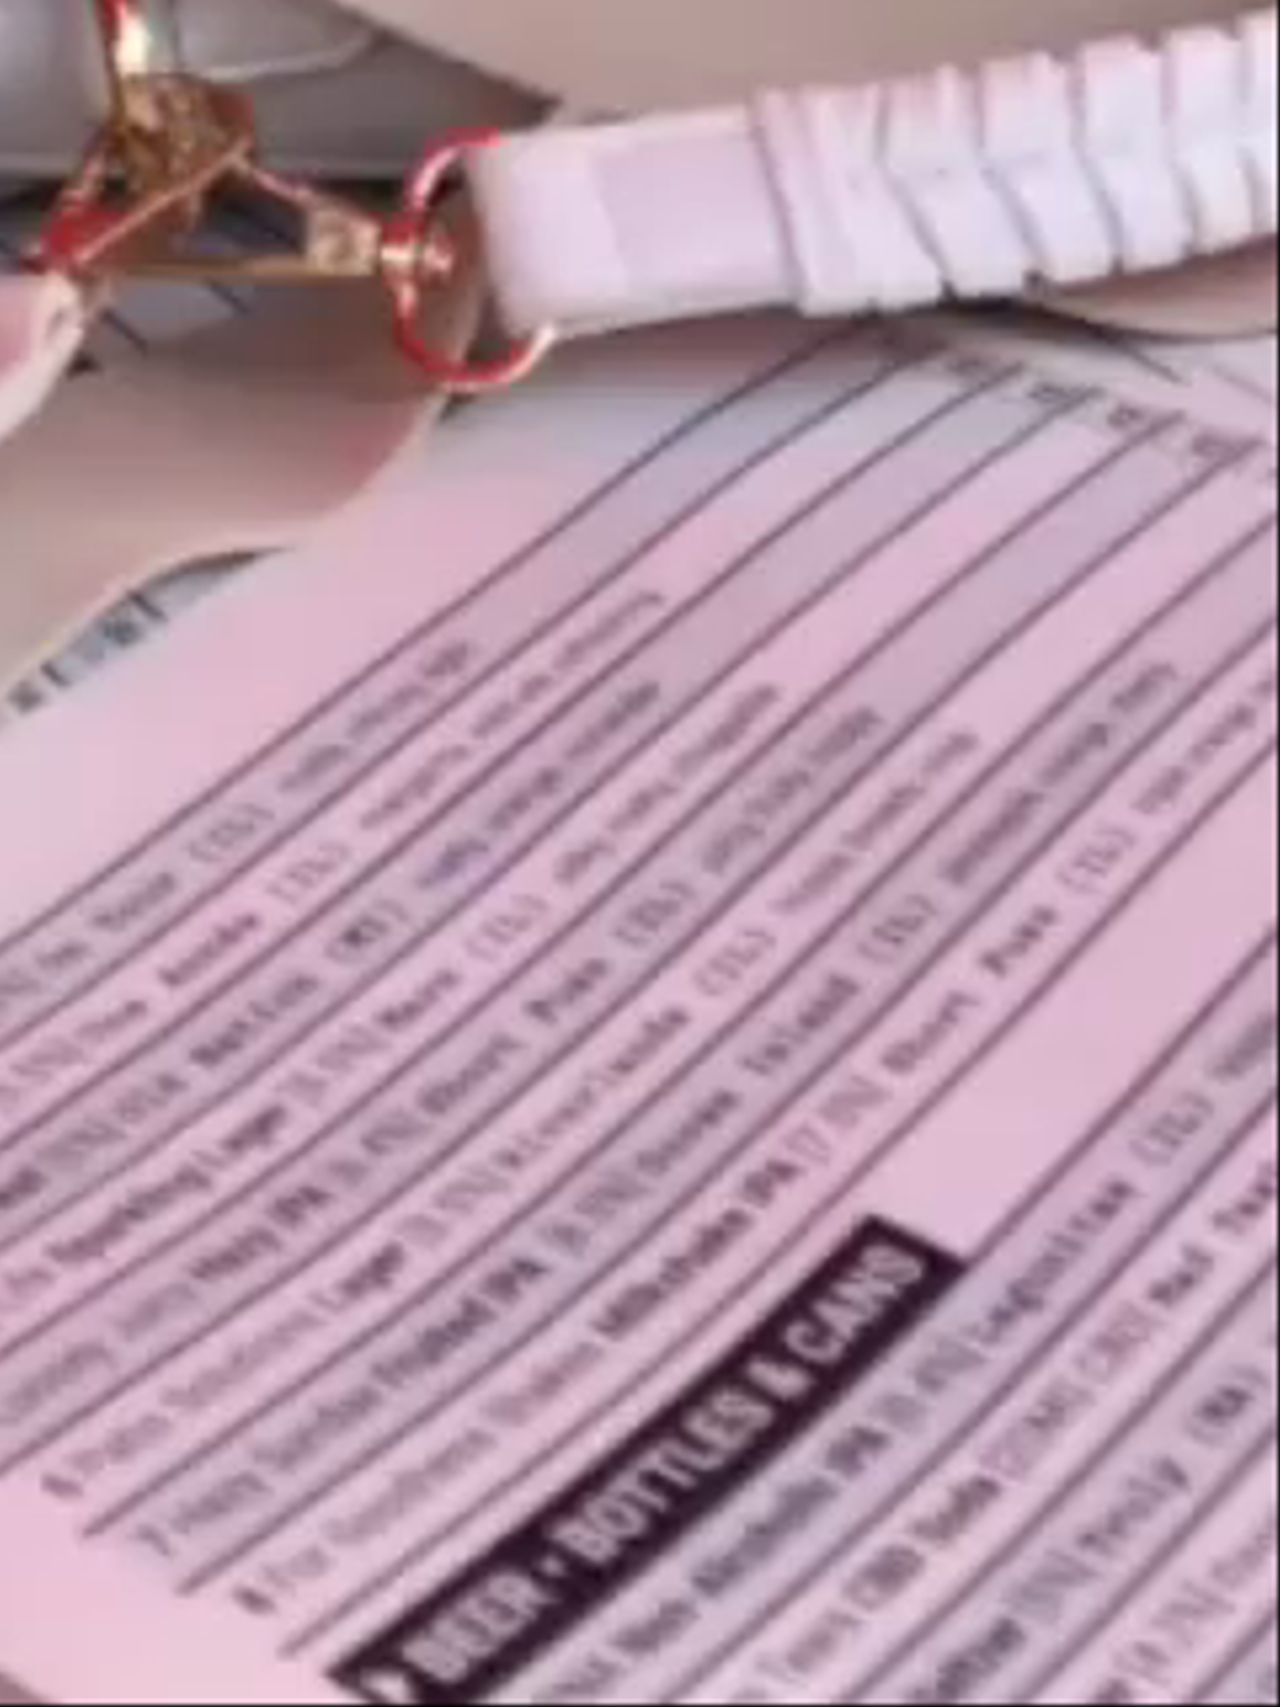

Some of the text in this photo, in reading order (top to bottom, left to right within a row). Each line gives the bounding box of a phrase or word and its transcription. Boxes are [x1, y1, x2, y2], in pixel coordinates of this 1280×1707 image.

[390, 1566, 563, 1686] BEER
[538, 1376, 782, 1567] BOTTLES
[765, 1230, 936, 1369] CANS
